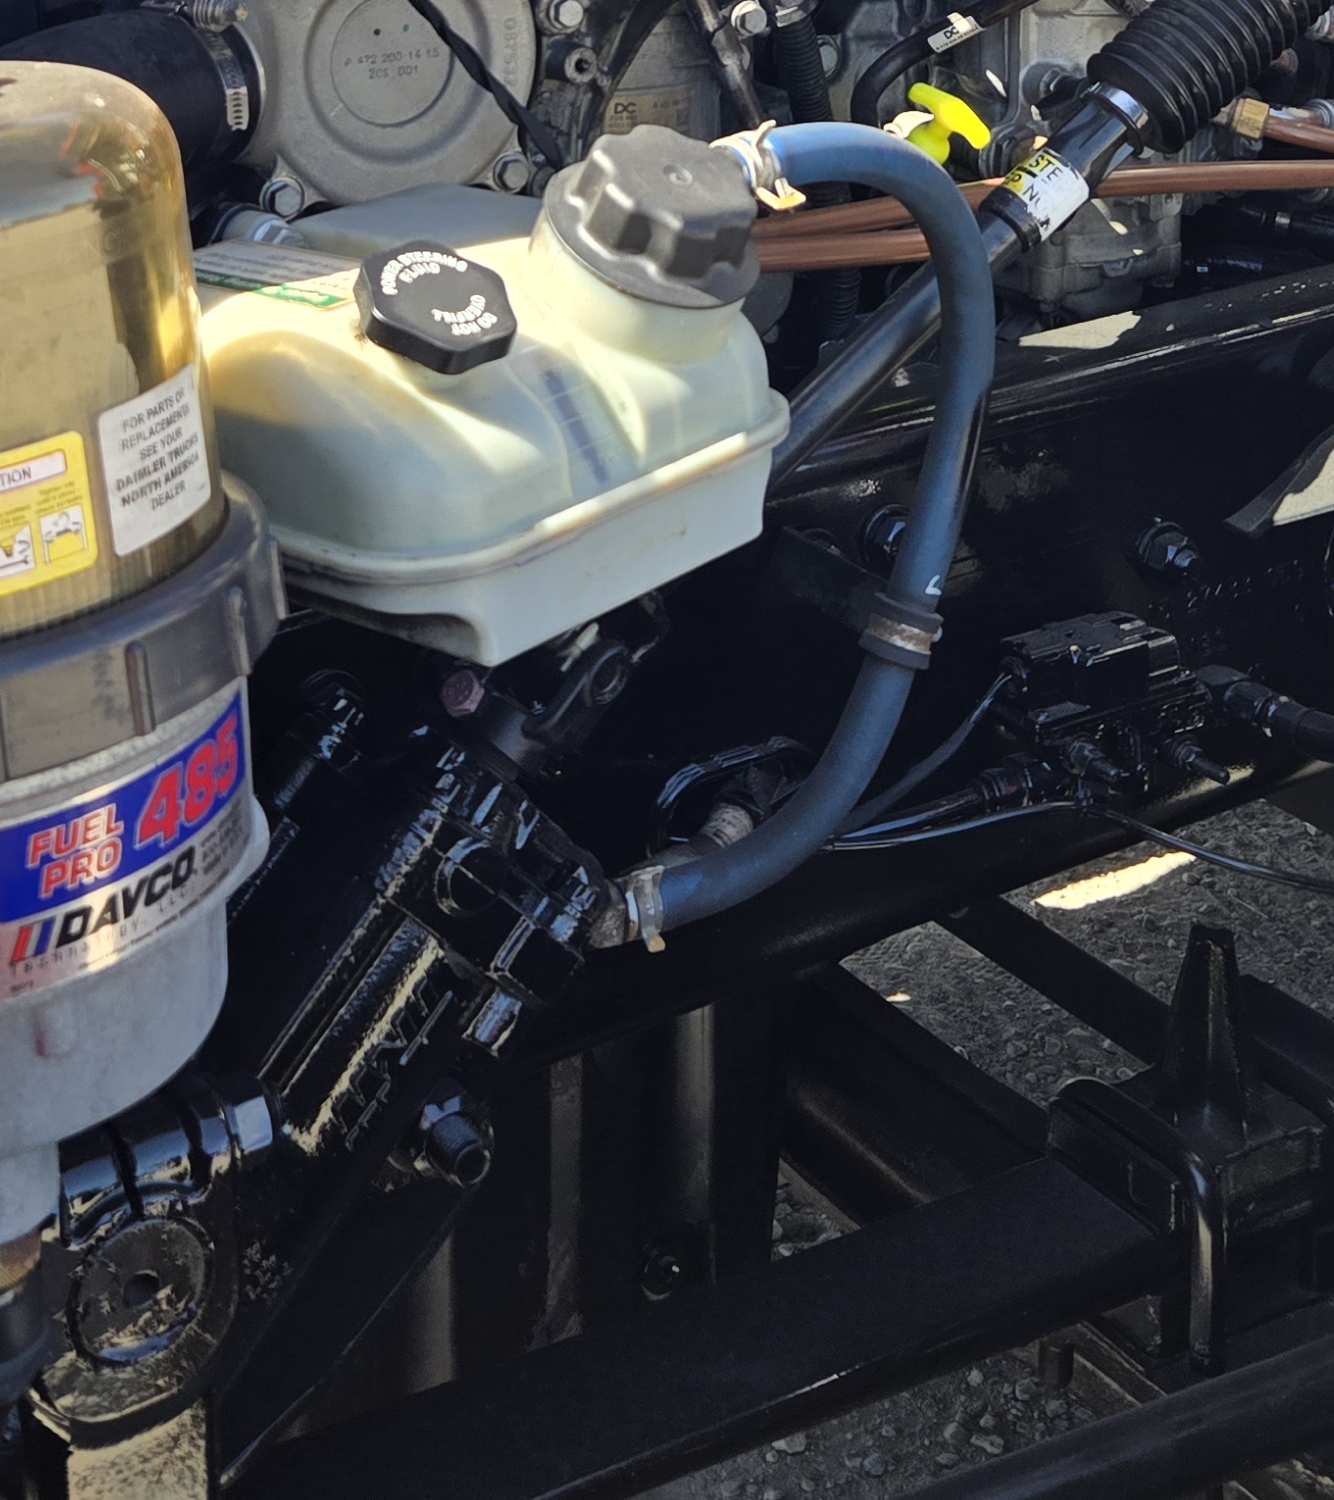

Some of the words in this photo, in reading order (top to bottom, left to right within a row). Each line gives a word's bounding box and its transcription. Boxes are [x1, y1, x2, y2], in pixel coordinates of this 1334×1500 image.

[613, 102, 636, 114] DC
[380, 259, 404, 295] POWER
[397, 250, 468, 273] STEERING
[398, 262, 441, 284] FLUID
[430, 294, 486, 324] OVERFILL
[477, 311, 498, 329] DO
[451, 321, 482, 336] NOT
[120, 402, 191, 451] REPLACEMENTS
[122, 412, 146, 432] FOR
[146, 396, 175, 423] PARTS
[116, 457, 167, 492] DAIMLER
[168, 431, 199, 464] TRUCKS
[140, 442, 159, 462] SEE
[160, 426, 183, 449] YOUR
[120, 478, 162, 508] NORTH
[164, 450, 200, 485] AMERICA
[151, 479, 186, 510] DEALER
[27, 802, 125, 868] FUEL
[134, 711, 238, 850] 485
[39, 837, 122, 899] PRO
[55, 845, 196, 949] DAVCO
